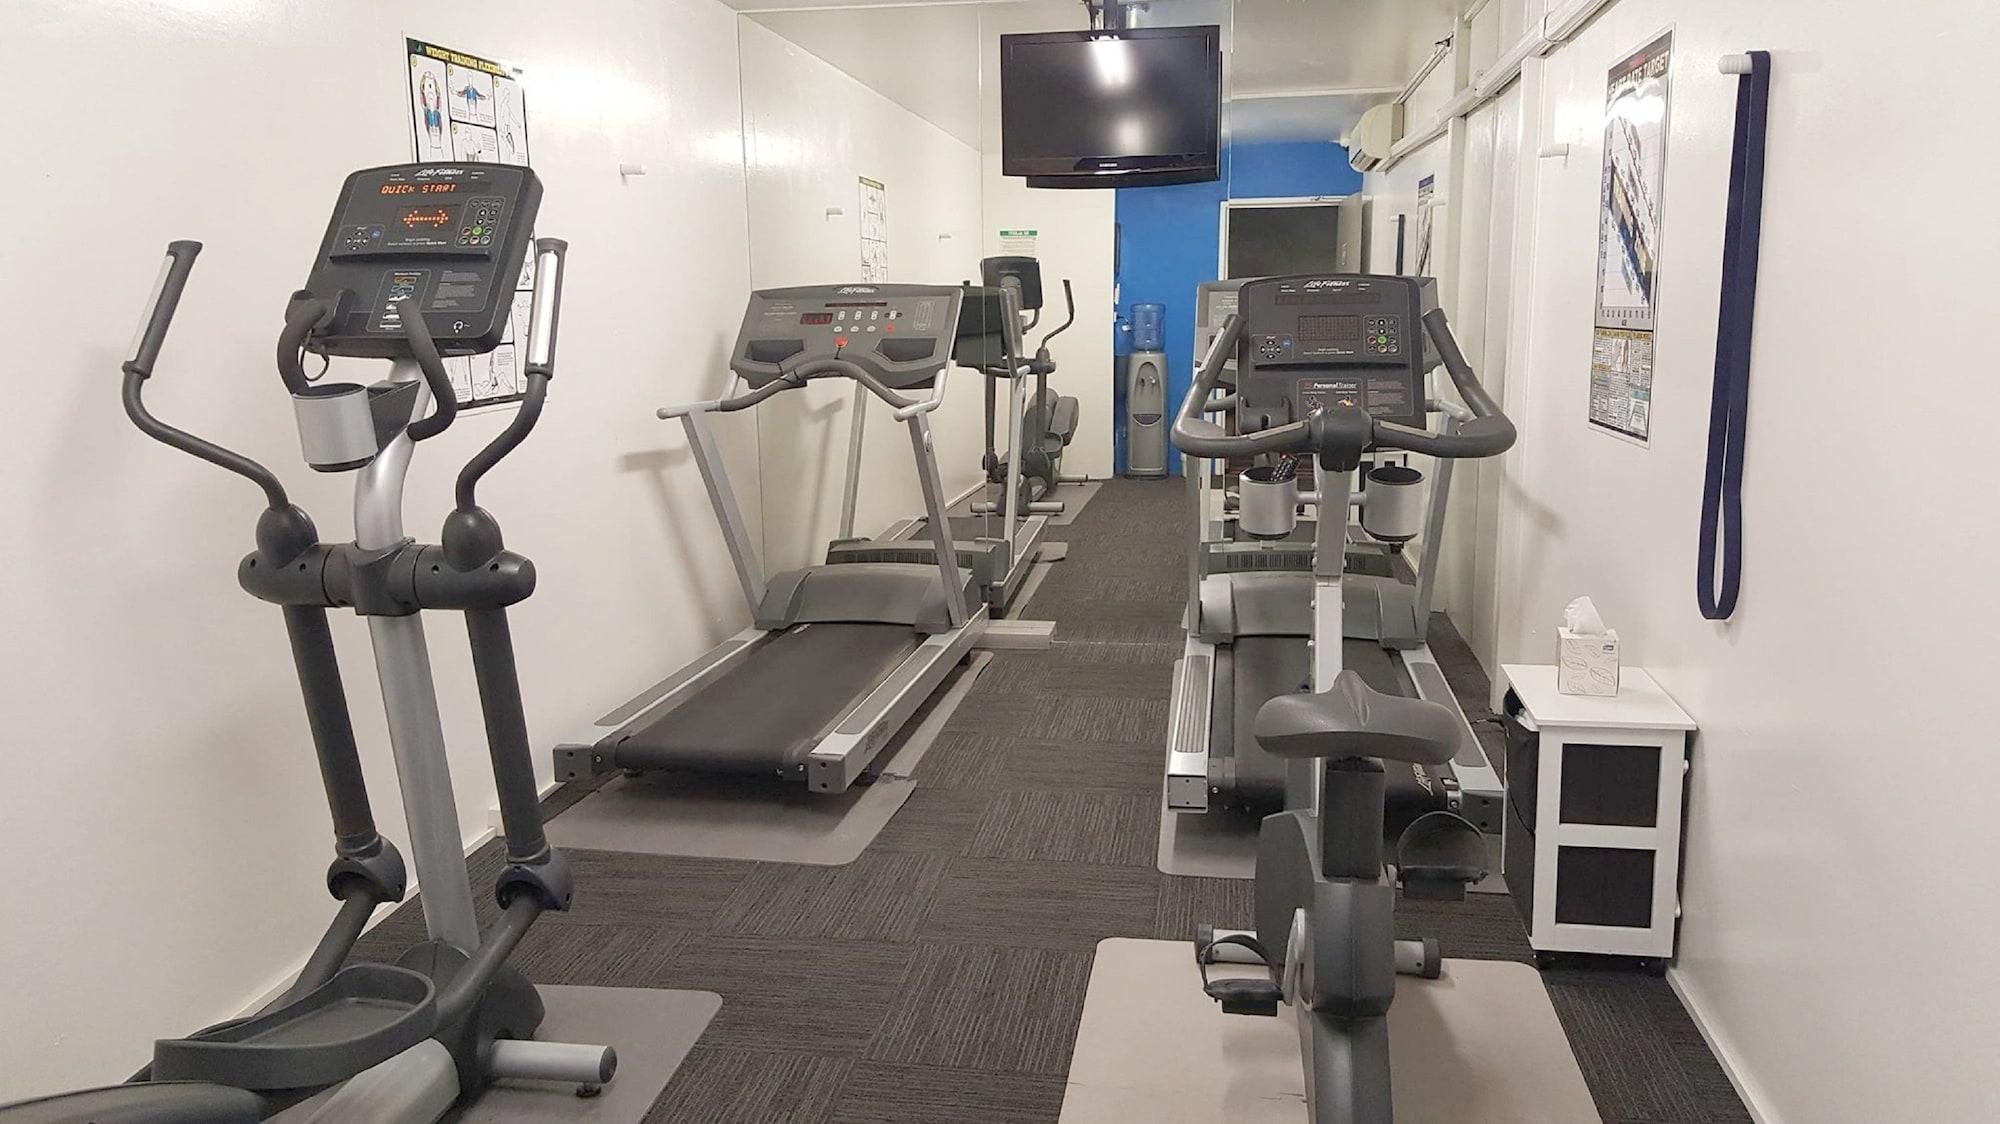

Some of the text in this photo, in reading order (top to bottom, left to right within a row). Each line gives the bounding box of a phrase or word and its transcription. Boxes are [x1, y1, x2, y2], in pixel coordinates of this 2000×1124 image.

[450, 53, 478, 68] TRAINING
[1643, 50, 1670, 78] TARGET
[381, 183, 456, 194] QUICK START
